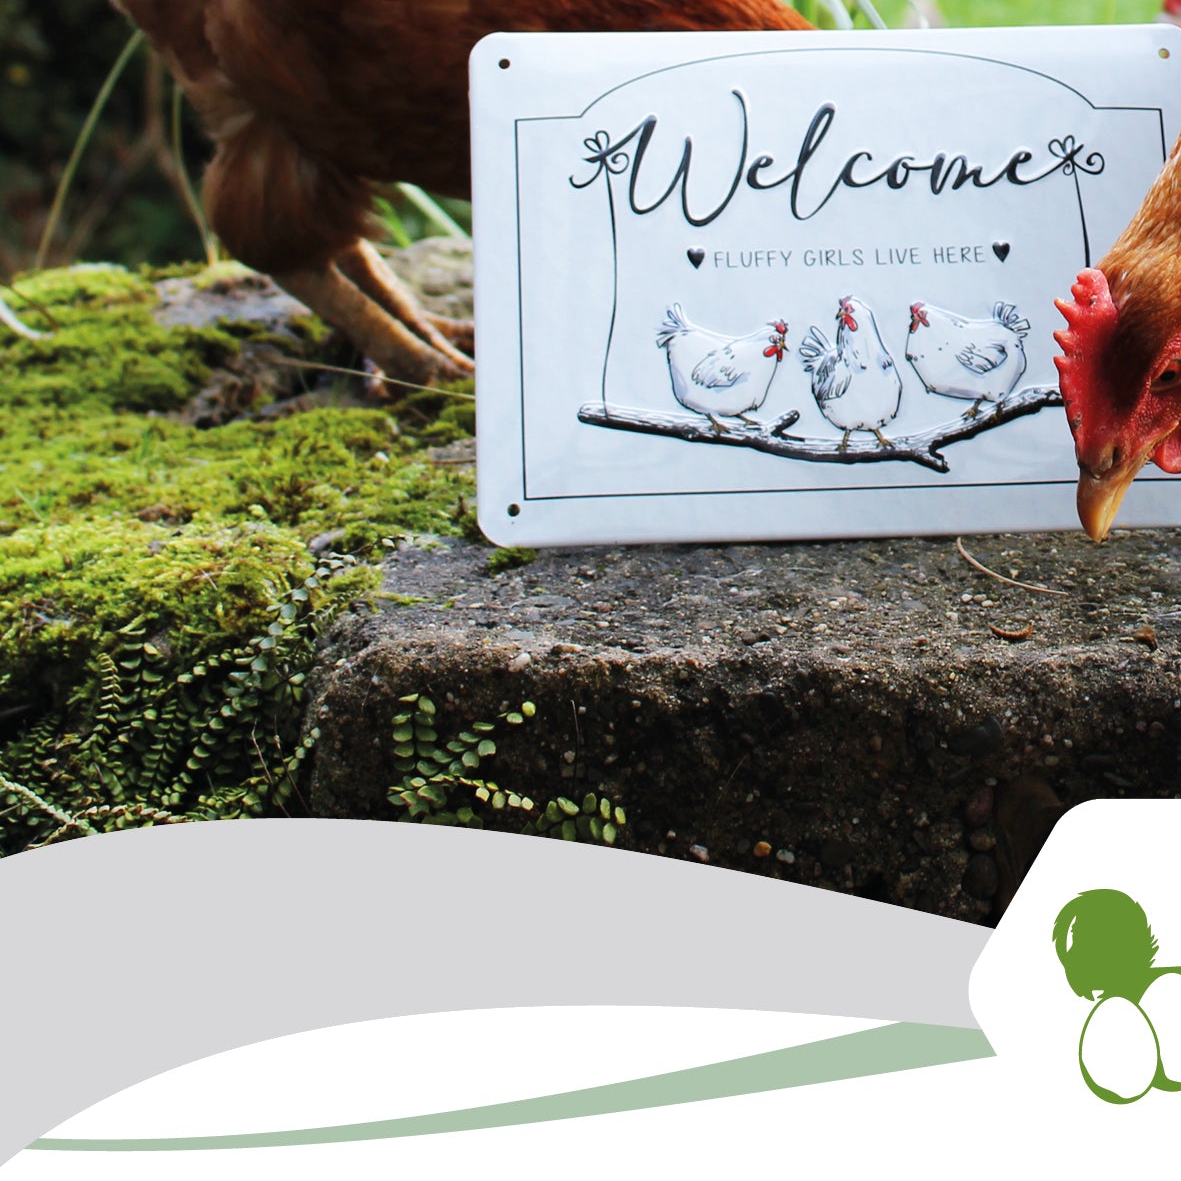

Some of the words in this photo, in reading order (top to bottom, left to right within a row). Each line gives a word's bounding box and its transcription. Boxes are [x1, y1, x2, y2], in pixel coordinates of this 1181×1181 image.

[600, 89, 1075, 228] Welcome
[713, 250, 793, 268] FLUFFY
[803, 249, 865, 267] GIRLS
[875, 247, 922, 265] LIVE
[933, 245, 987, 264] HERE
